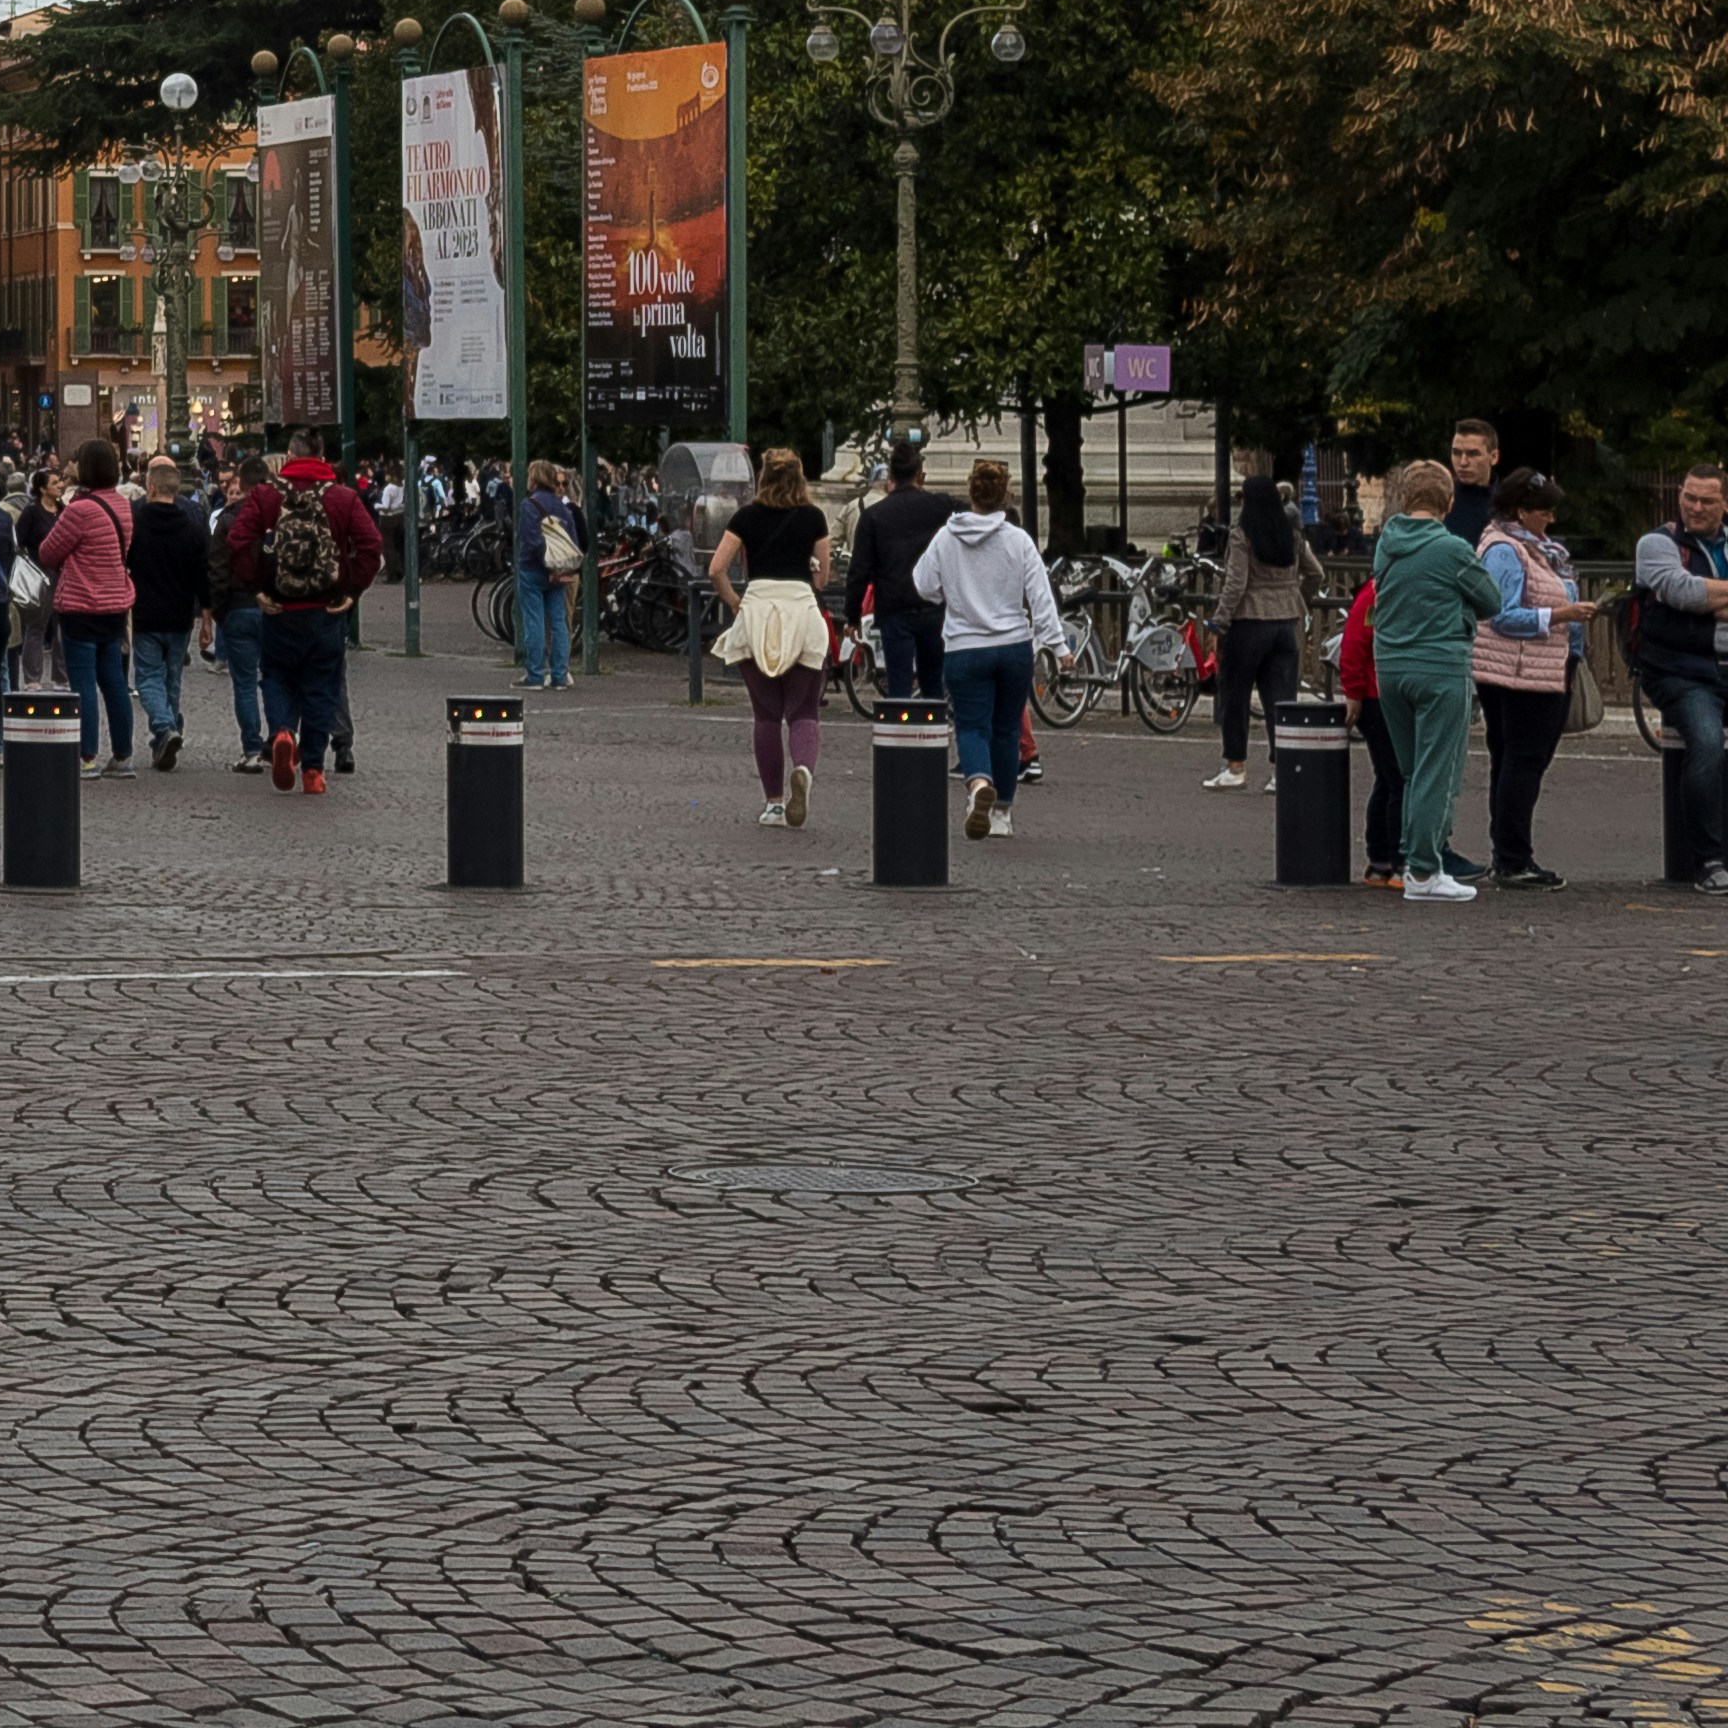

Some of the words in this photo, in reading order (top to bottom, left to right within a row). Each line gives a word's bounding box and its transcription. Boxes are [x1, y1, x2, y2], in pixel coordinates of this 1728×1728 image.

[406, 140, 451, 173] TEATRO
[406, 165, 486, 204] FILARMONICO
[420, 198, 478, 231] ABBONATI
[435, 230, 452, 260] AL
[452, 228, 479, 259] 2023
[627, 249, 658, 296] 100
[660, 258, 695, 294] volte
[641, 294, 686, 338] prima
[669, 322, 707, 359] volta
[1127, 357, 1157, 380] WC
